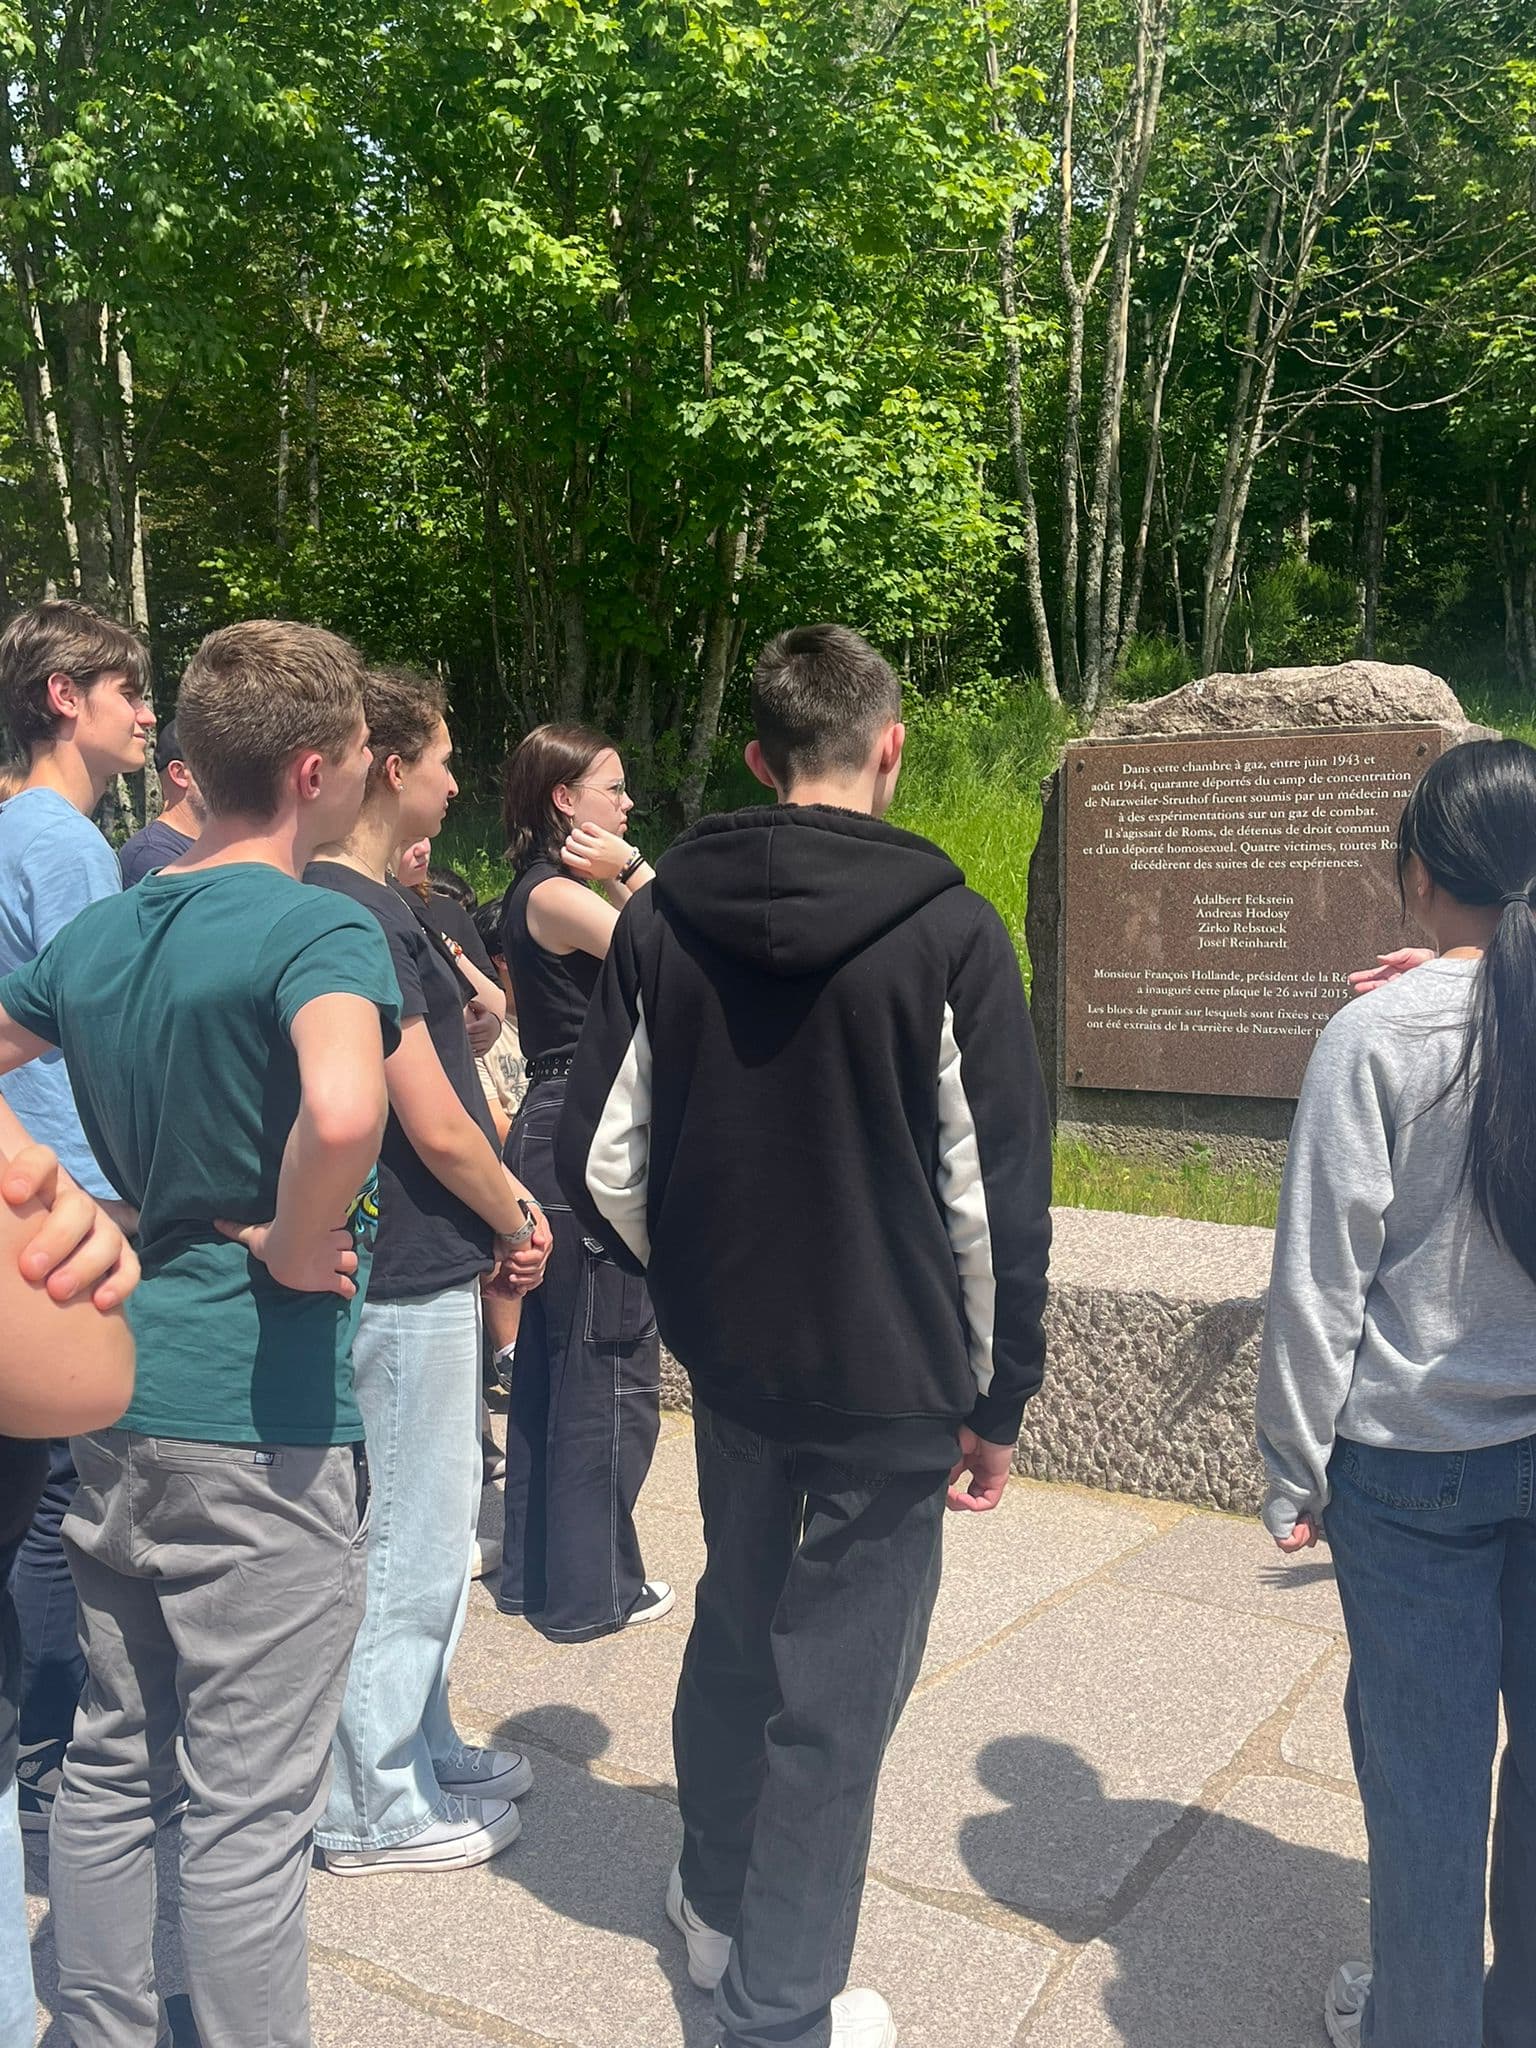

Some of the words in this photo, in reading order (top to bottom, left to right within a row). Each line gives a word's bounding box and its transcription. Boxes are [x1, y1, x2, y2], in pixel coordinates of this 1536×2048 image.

[1122, 763, 1150, 774] Dans
[1153, 762, 1179, 773] cette
[1182, 760, 1232, 772] chambre
[1235, 759, 1241, 770] à
[1243, 760, 1267, 772] gaz,
[1270, 758, 1300, 768] entre
[1304, 756, 1327, 769] juin
[1332, 754, 1360, 766] 1943
[1364, 755, 1376, 765] et
[1091, 781, 1115, 791] août
[1119, 778, 1147, 791] 1944,
[1150, 780, 1199, 792] quarante
[1202, 776, 1251, 789] déportés
[1254, 775, 1270, 786] du
[1273, 774, 1305, 787] camp
[1309, 773, 1323, 784] de
[1326, 770, 1411, 783] concentration
[1084, 797, 1098, 807] de
[1100, 793, 1211, 807] Natzweiler-Struthof
[1212, 793, 1247, 804] furent
[1251, 791, 1291, 802] soumis
[1295, 792, 1314, 803] par
[1318, 792, 1333, 800] un
[1337, 787, 1389, 799] médecin
[1393, 789, 1412, 798] naz
[1118, 811, 1125, 822] à
[1127, 811, 1145, 822] des
[1148, 809, 1245, 824] expérimentations
[1248, 810, 1267, 819] sur
[1270, 810, 1285, 818] un
[1288, 809, 1308, 820] gaz
[1311, 806, 1326, 817] de
[1329, 805, 1378, 817] combat.
[1104, 828, 1113, 838] Il
[1115, 827, 1162, 840] s'agissait
[1165, 827, 1179, 837] de
[1181, 827, 1217, 838] Roms,
[1220, 825, 1234, 836] de
[1236, 824, 1282, 836] détenus
[1285, 824, 1300, 835] de
[1302, 823, 1333, 834] droit
[1335, 825, 1390, 833] commun
[1082, 846, 1093, 855] et
[1095, 843, 1119, 855] d'un
[1122, 843, 1164, 856] déporté
[1167, 842, 1237, 853] homosexuel.
[1240, 841, 1281, 854] Quatre
[1283, 840, 1336, 852] victimes,
[1339, 840, 1377, 850] toutes
[1380, 839, 1401, 850] Ro
[1130, 859, 1191, 870] décédèrent
[1194, 858, 1212, 869] des
[1215, 858, 1248, 869] suites
[1251, 858, 1265, 869] de
[1268, 860, 1286, 868] ces
[1289, 857, 1363, 871] expériences.
[1192, 894, 1242, 905] Adalbert
[1245, 894, 1294, 905] Eckstein
[1196, 908, 1242, 918] Andreas
[1246, 908, 1290, 920] Hodosy
[1198, 922, 1230, 933] Zirko
[1233, 922, 1287, 933] Rebstock
[1197, 937, 1228, 950] Josef
[1230, 937, 1288, 948] Reinhardt
[1093, 969, 1142, 979] Monsieur
[1144, 969, 1189, 982] François
[1191, 970, 1244, 982] Hollande,
[1246, 971, 1299, 983] président
[1301, 971, 1316, 982] de
[1319, 971, 1328, 982] la
[1145, 984, 1192, 996] inauguré
[1194, 986, 1220, 996] cette
[1223, 986, 1260, 998] plaque
[1263, 987, 1273, 997] le
[1275, 987, 1290, 997] 26
[1292, 988, 1317, 998] avril
[1320, 988, 1352, 999] 2015.
[1088, 1004, 1104, 1014] Les
[1107, 1003, 1133, 1014] blocs
[1135, 1004, 1149, 1015] de
[1151, 1006, 1182, 1017] granit
[1184, 1008, 1202, 1016] sur
[1205, 1006, 1248, 1019] lesquels
[1250, 1010, 1274, 1019] sont
[1277, 1008, 1309, 1020] fixées
[1086, 1021, 1104, 1029] ont
[1106, 1019, 1121, 1029] été
[1123, 1021, 1162, 1031] extraits
[1164, 1021, 1177, 1031] de
[1180, 1021, 1190, 1032] la
[1192, 1022, 1234, 1033] carrière
[1236, 1023, 1250, 1033] de
[1252, 1023, 1312, 1036] Natzweiler
